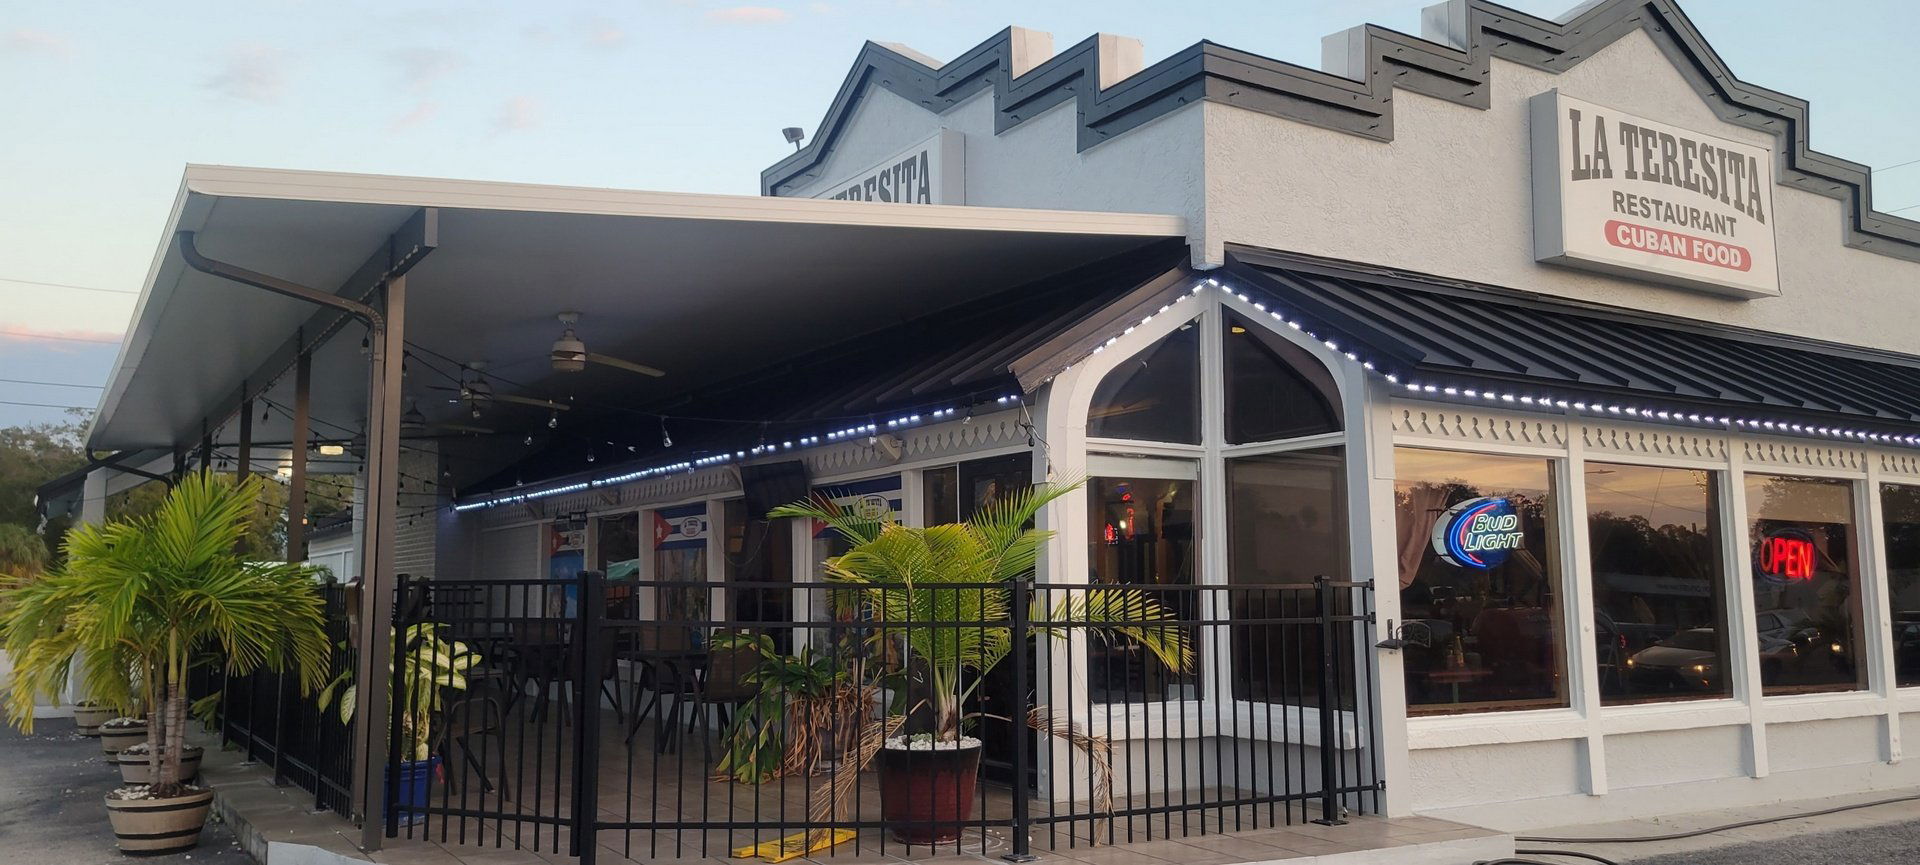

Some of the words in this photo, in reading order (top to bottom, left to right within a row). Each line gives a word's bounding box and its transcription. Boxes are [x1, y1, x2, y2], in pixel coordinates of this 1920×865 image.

[1569, 107, 1613, 181] LA
[1619, 121, 1766, 225] TERESITA
[1612, 190, 1737, 237] RESTAURANT
[1616, 225, 1687, 257] CUBAN
[1693, 240, 1742, 268] FOOD
[1463, 531, 1523, 551] LIGHT
[1471, 513, 1518, 533] BUD
[1760, 537, 1814, 580] OPEN
